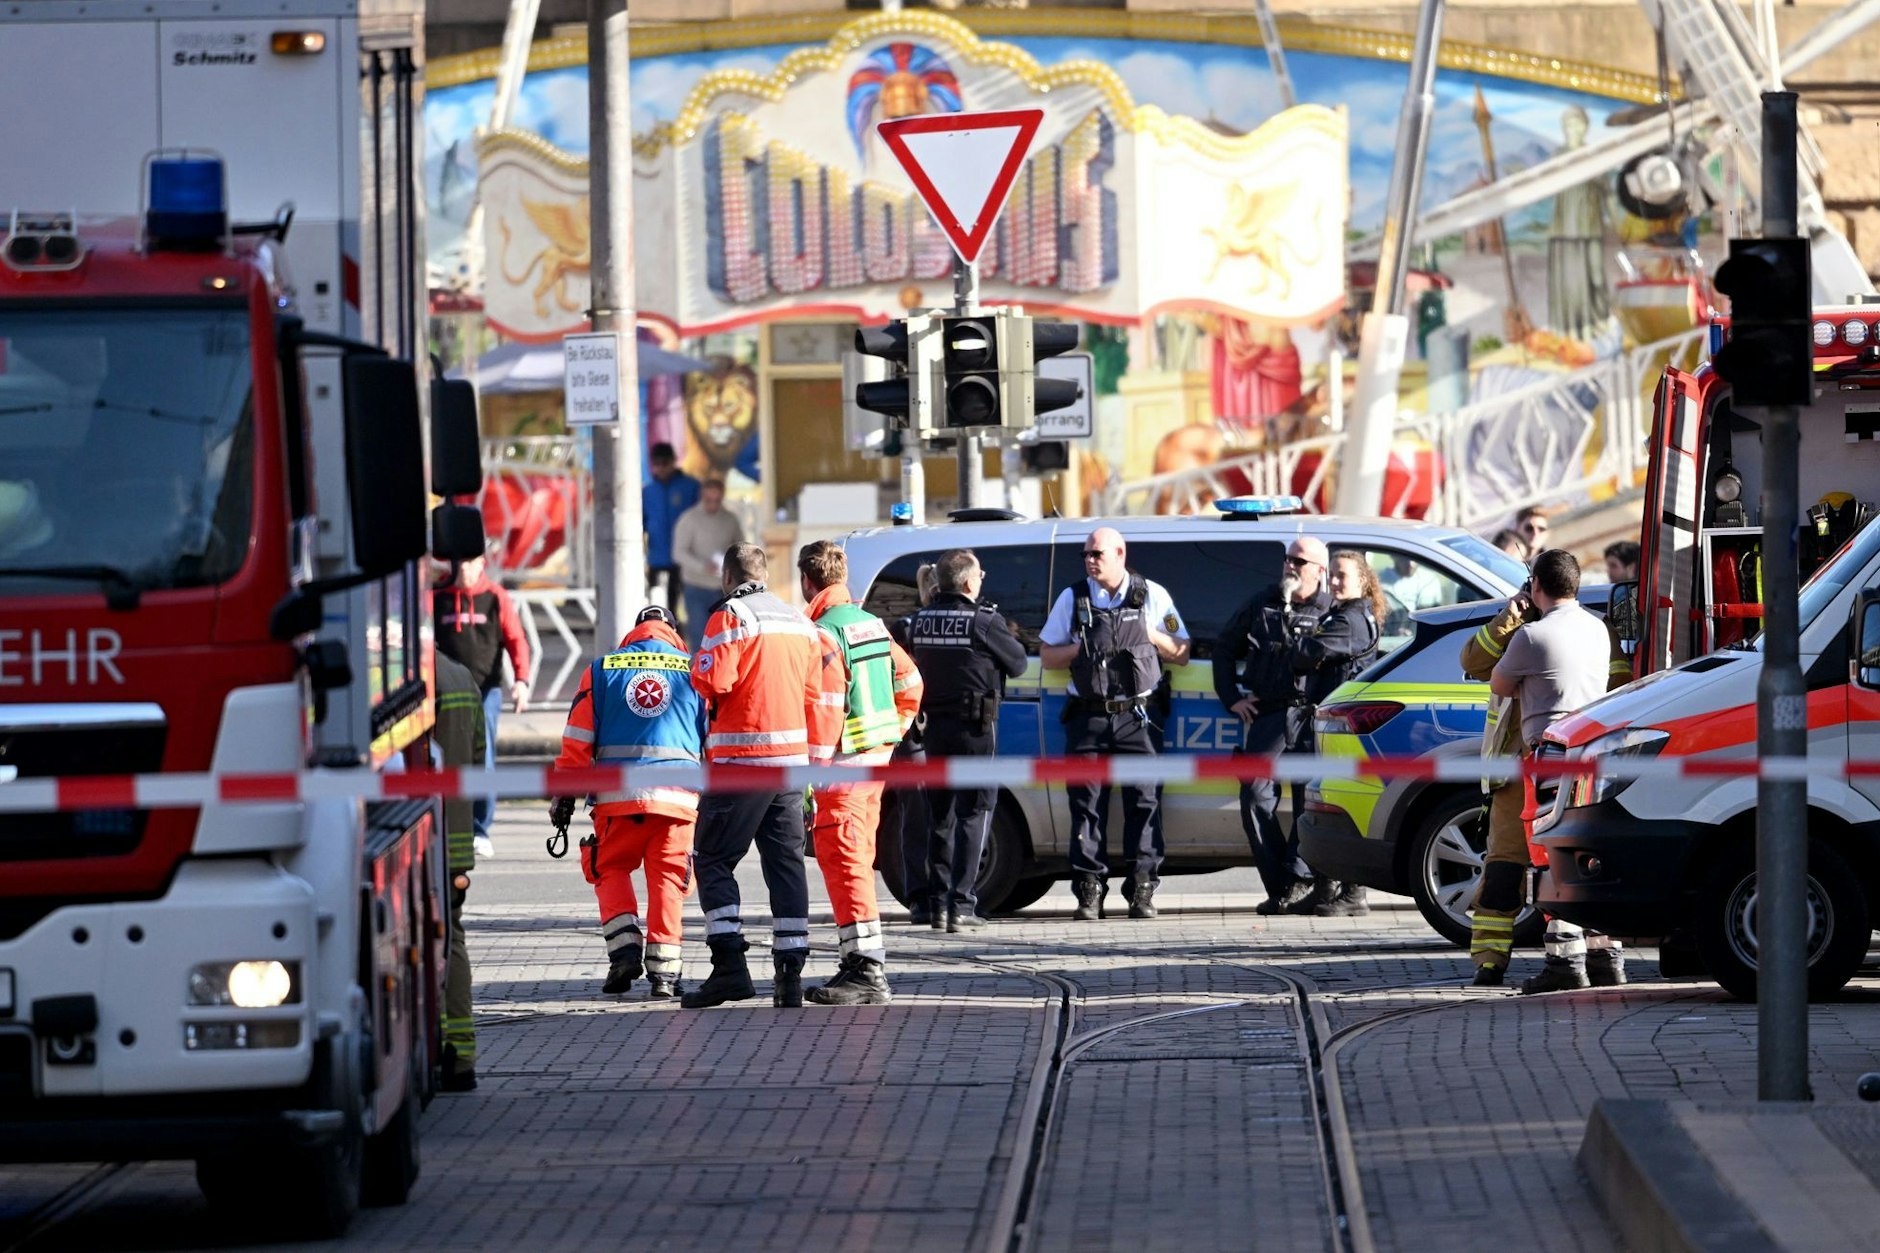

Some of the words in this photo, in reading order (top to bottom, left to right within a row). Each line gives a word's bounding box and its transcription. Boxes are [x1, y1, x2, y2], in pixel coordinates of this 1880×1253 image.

[173, 50, 257, 66] Schmitz
[914, 618, 971, 636] POLIZEI
[0, 627, 126, 686] EHR
[664, 663, 689, 671] MA
